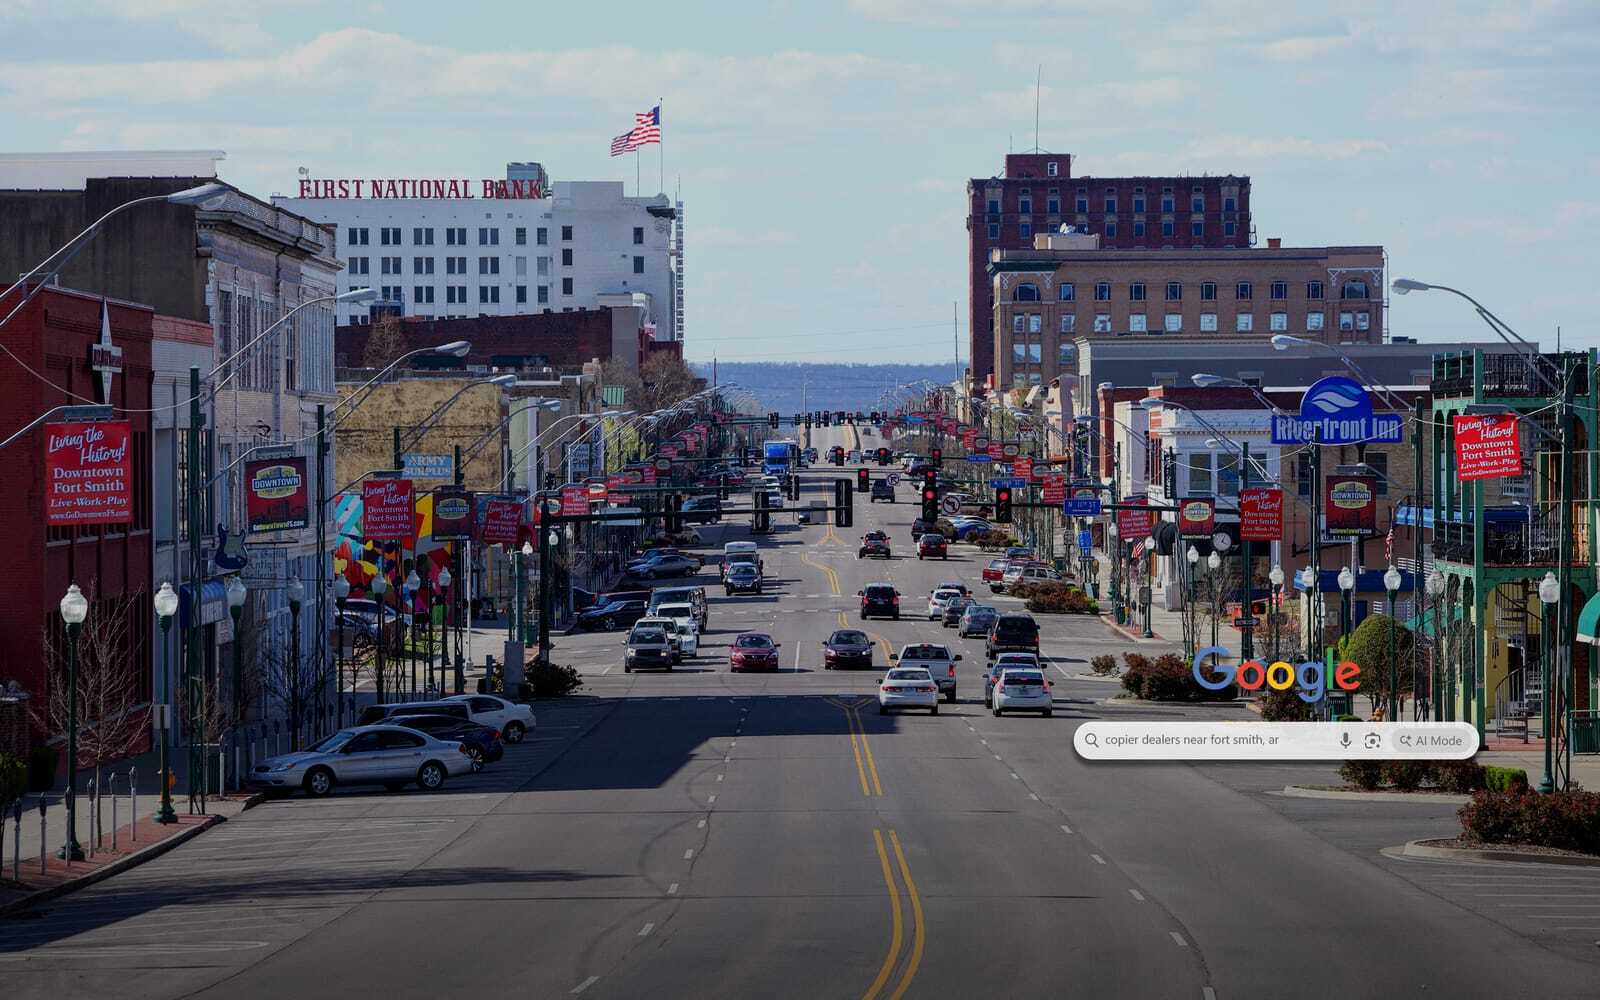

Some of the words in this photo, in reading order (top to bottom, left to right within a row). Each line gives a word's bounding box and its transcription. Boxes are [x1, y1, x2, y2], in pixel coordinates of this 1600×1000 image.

[299, 179, 365, 199] FIRST
[370, 179, 474, 199] NATIONAL
[481, 179, 543, 199] BANK
[1276, 418, 1366, 440] Riverfront
[1372, 418, 1399, 439] Inn
[1457, 421, 1482, 435] Living
[1480, 421, 1514, 441] History!
[49, 434, 83, 453] Living
[85, 425, 104, 443] the
[1461, 440, 1514, 451] Downtown
[80, 437, 127, 465] History!
[1462, 452, 1483, 461] Fort
[1485, 448, 1515, 458] Smith
[53, 467, 124, 479] Downtown
[54, 482, 81, 494] Fort
[84, 479, 124, 493] Smith
[254, 477, 299, 489] DOWNTOWN
